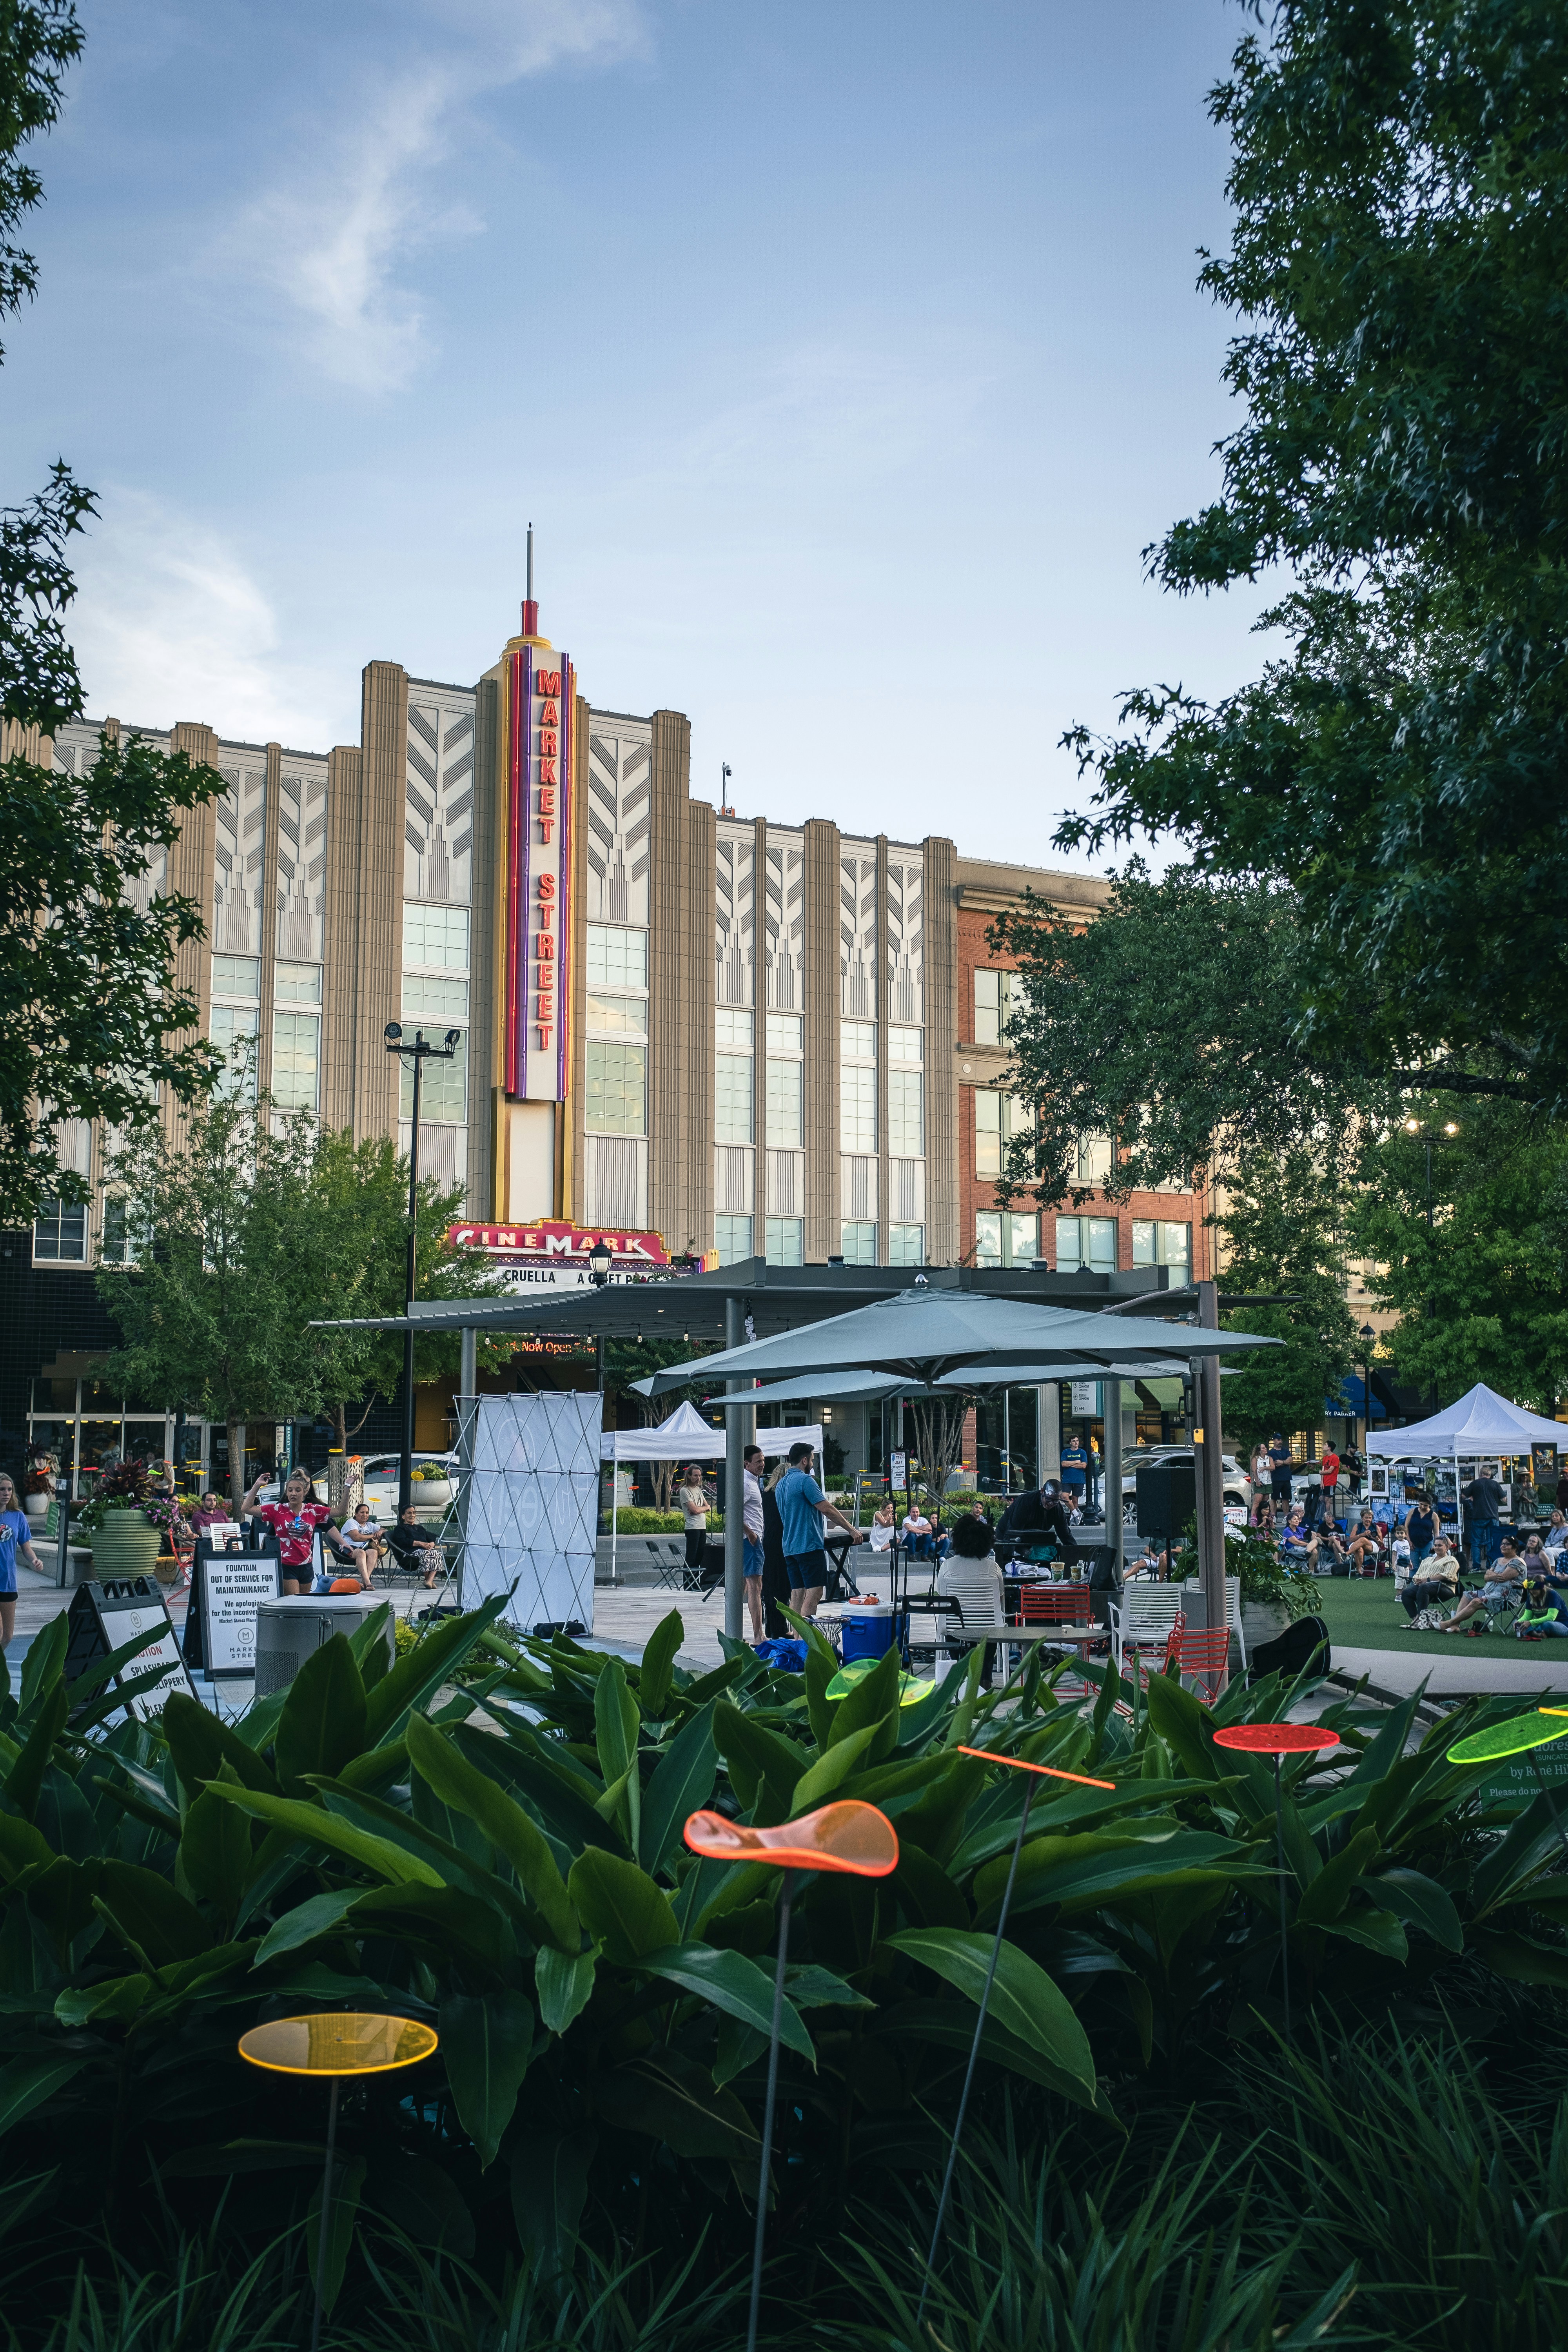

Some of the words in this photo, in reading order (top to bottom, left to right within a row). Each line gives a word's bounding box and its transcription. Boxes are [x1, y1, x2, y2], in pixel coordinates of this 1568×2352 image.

[536, 668, 561, 844] MARKET
[536, 873, 555, 1051] STREET
[504, 1270, 555, 1283] CRUELLA
[577, 1272, 584, 1284] A
[588, 1273, 622, 1284] QET
[522, 1341, 543, 1352] Now
[546, 1342, 572, 1354] Open
[216, 1586, 270, 1594] MAINTANINANCE
[133, 1646, 163, 1659] AUTION
[1510, 1767, 1523, 1779] by
[1490, 1788, 1517, 1796] Please
